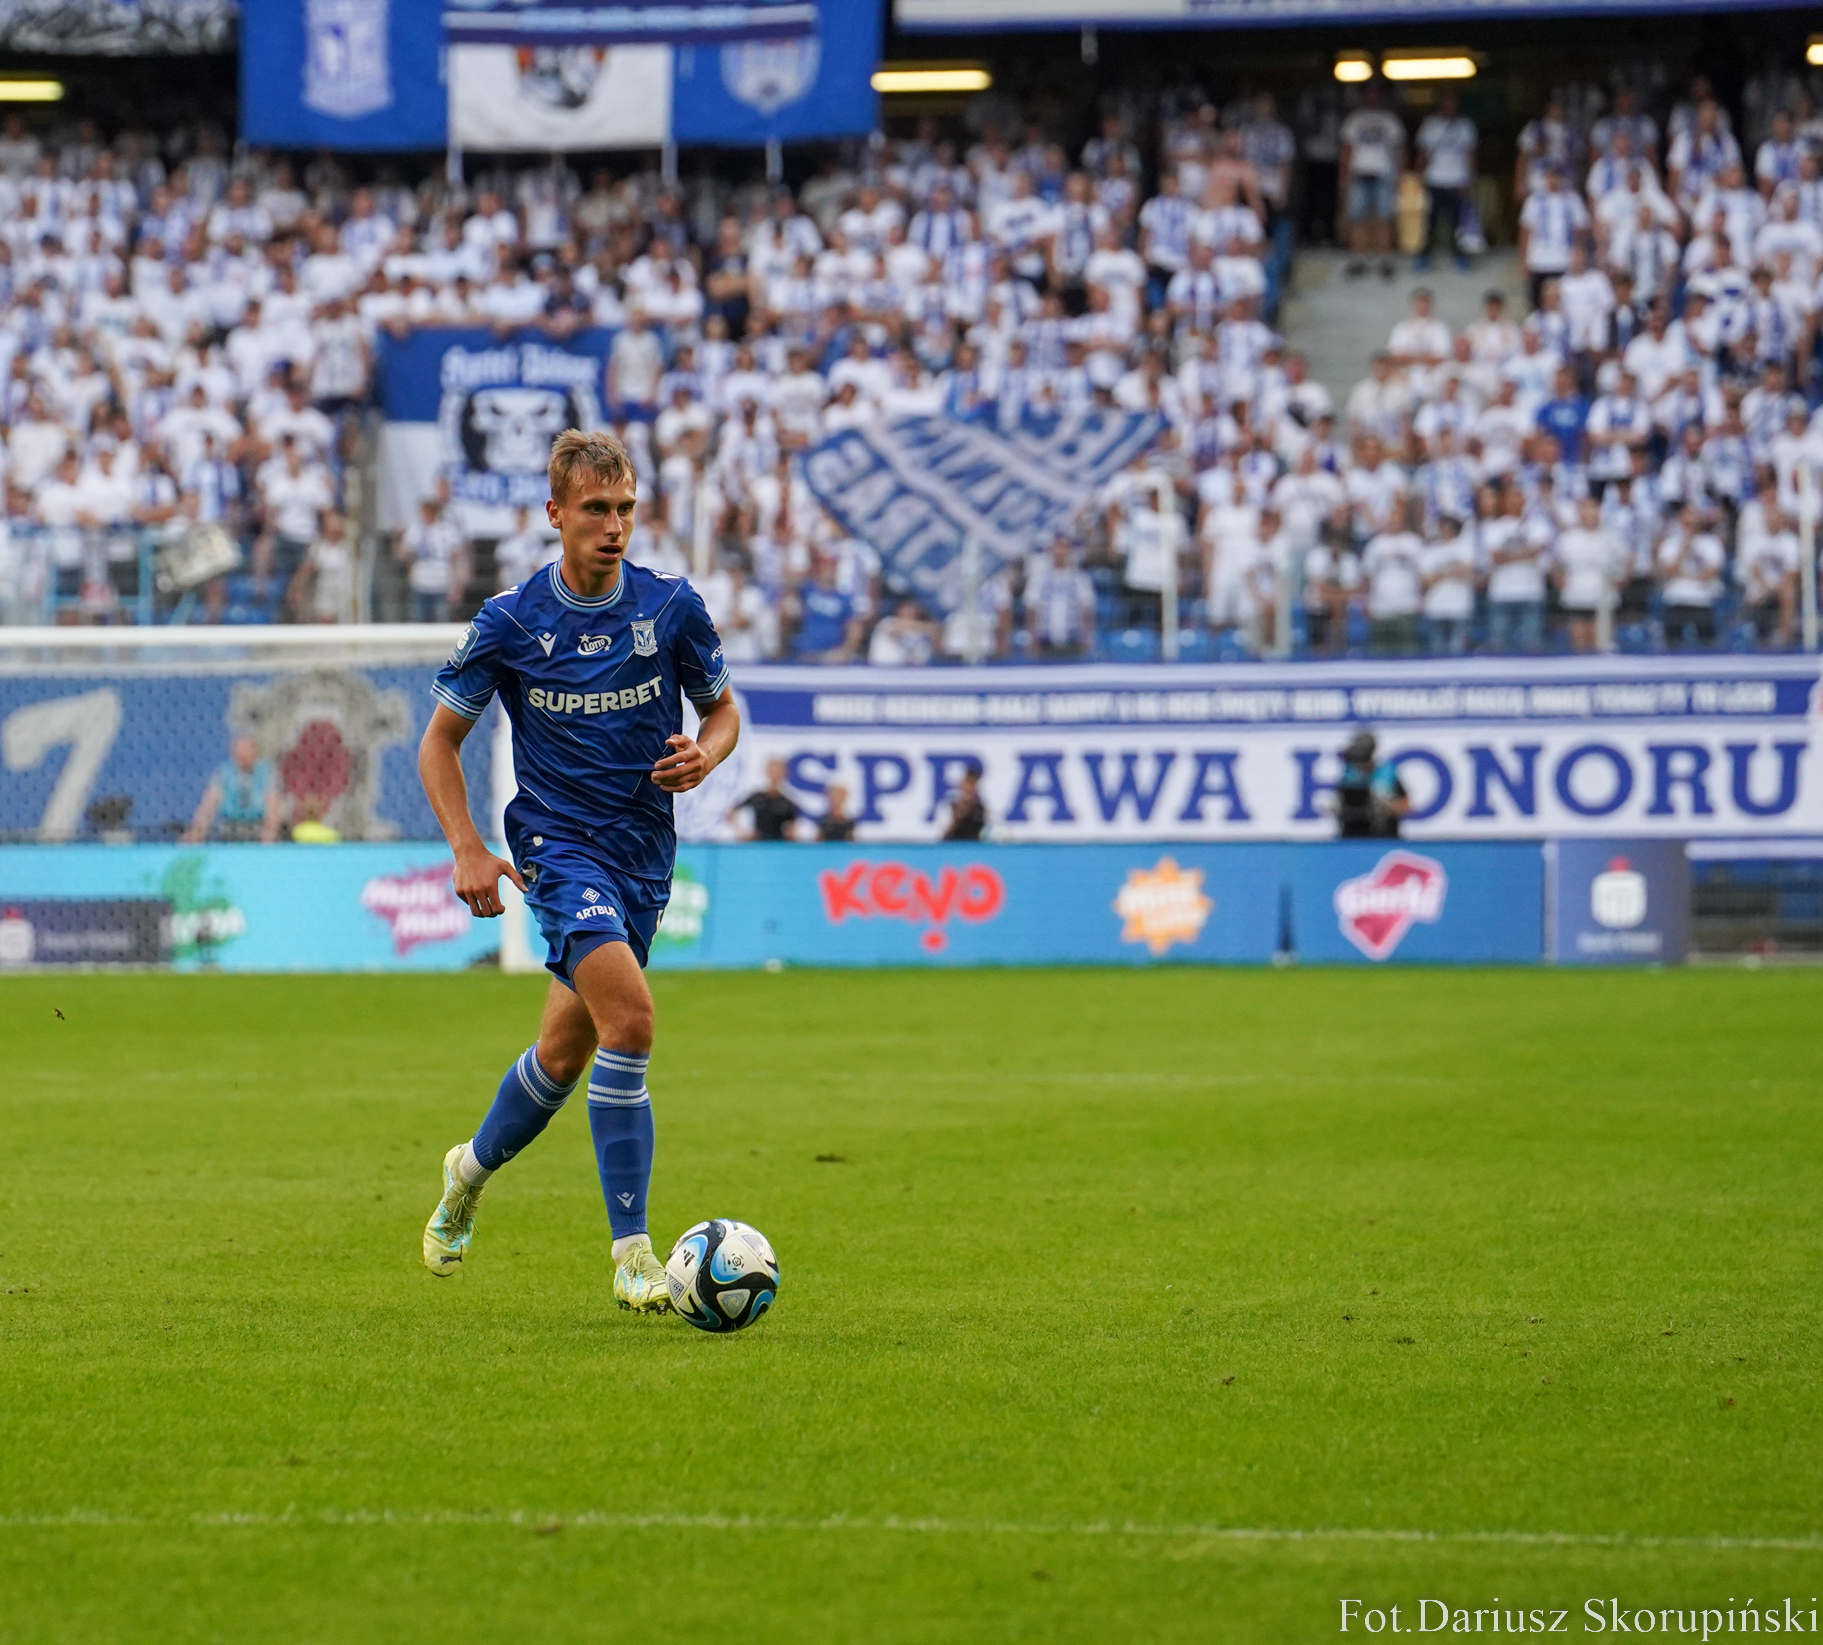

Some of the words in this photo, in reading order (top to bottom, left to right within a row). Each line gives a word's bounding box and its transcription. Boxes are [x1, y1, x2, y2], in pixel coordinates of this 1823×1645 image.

[582, 638, 606, 652] LOTTO
[528, 676, 662, 714] SUPERBET
[2, 686, 123, 840] 7
[786, 749, 1251, 823] SPRAWA
[1291, 741, 1808, 821] HONORU
[576, 905, 617, 921] ARTBUD
